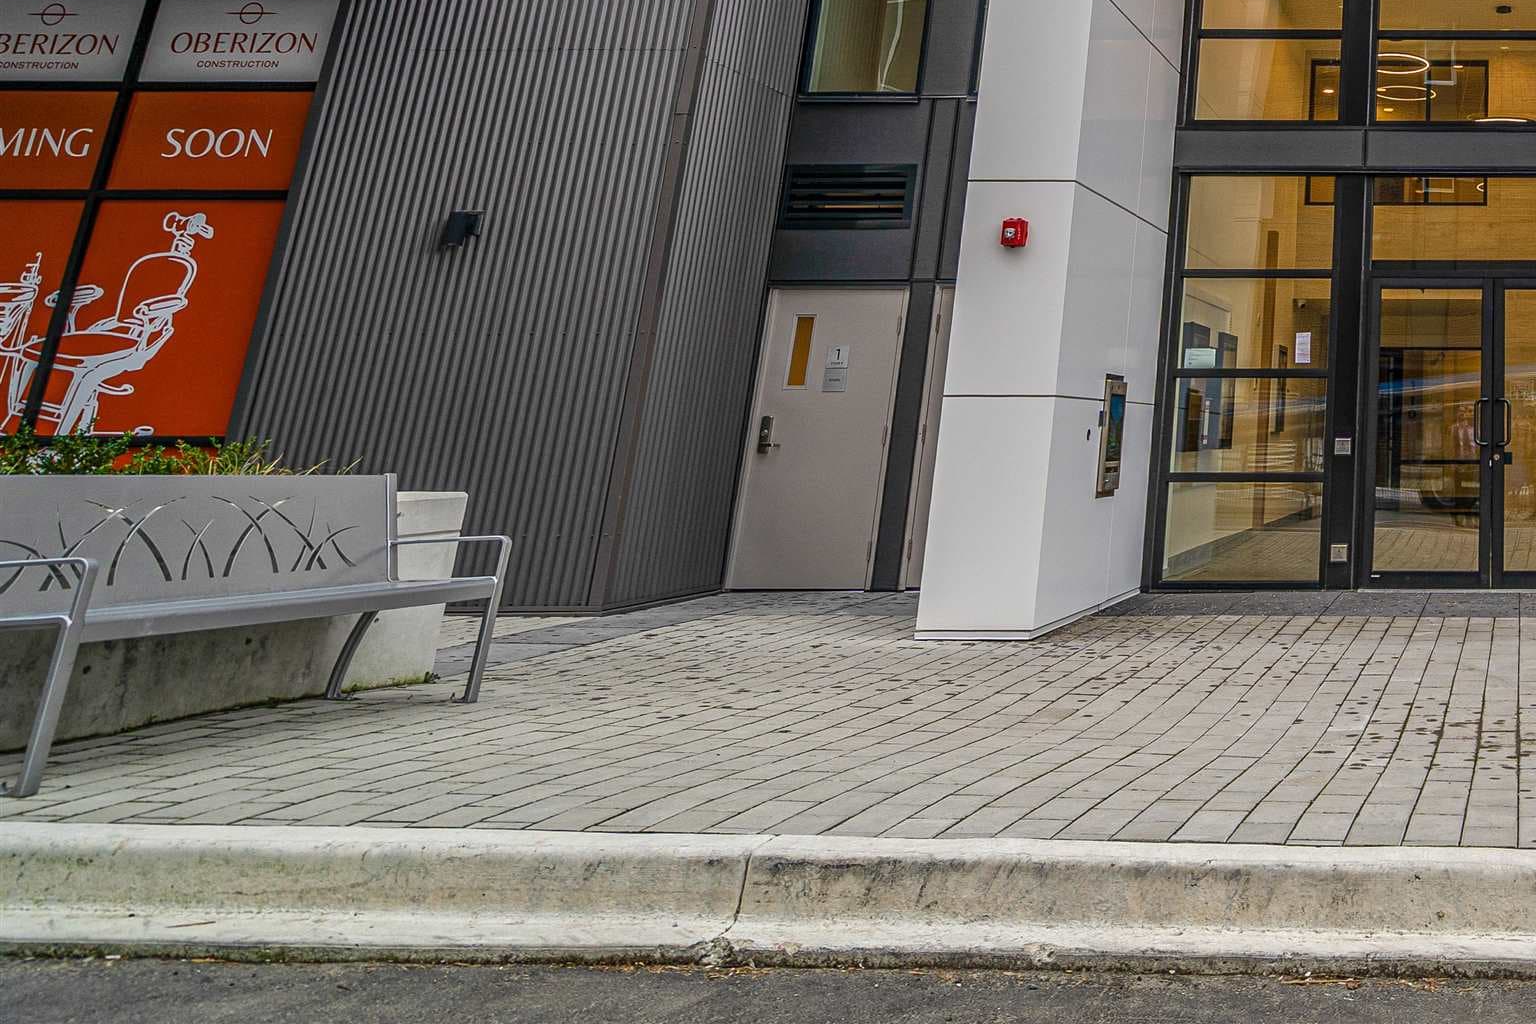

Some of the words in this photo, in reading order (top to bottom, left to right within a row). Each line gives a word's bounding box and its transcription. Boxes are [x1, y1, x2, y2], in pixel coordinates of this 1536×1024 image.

[170, 31, 318, 54] OBERIZON
[196, 59, 280, 68] CONSTRUCTION
[161, 128, 273, 158] SOON
